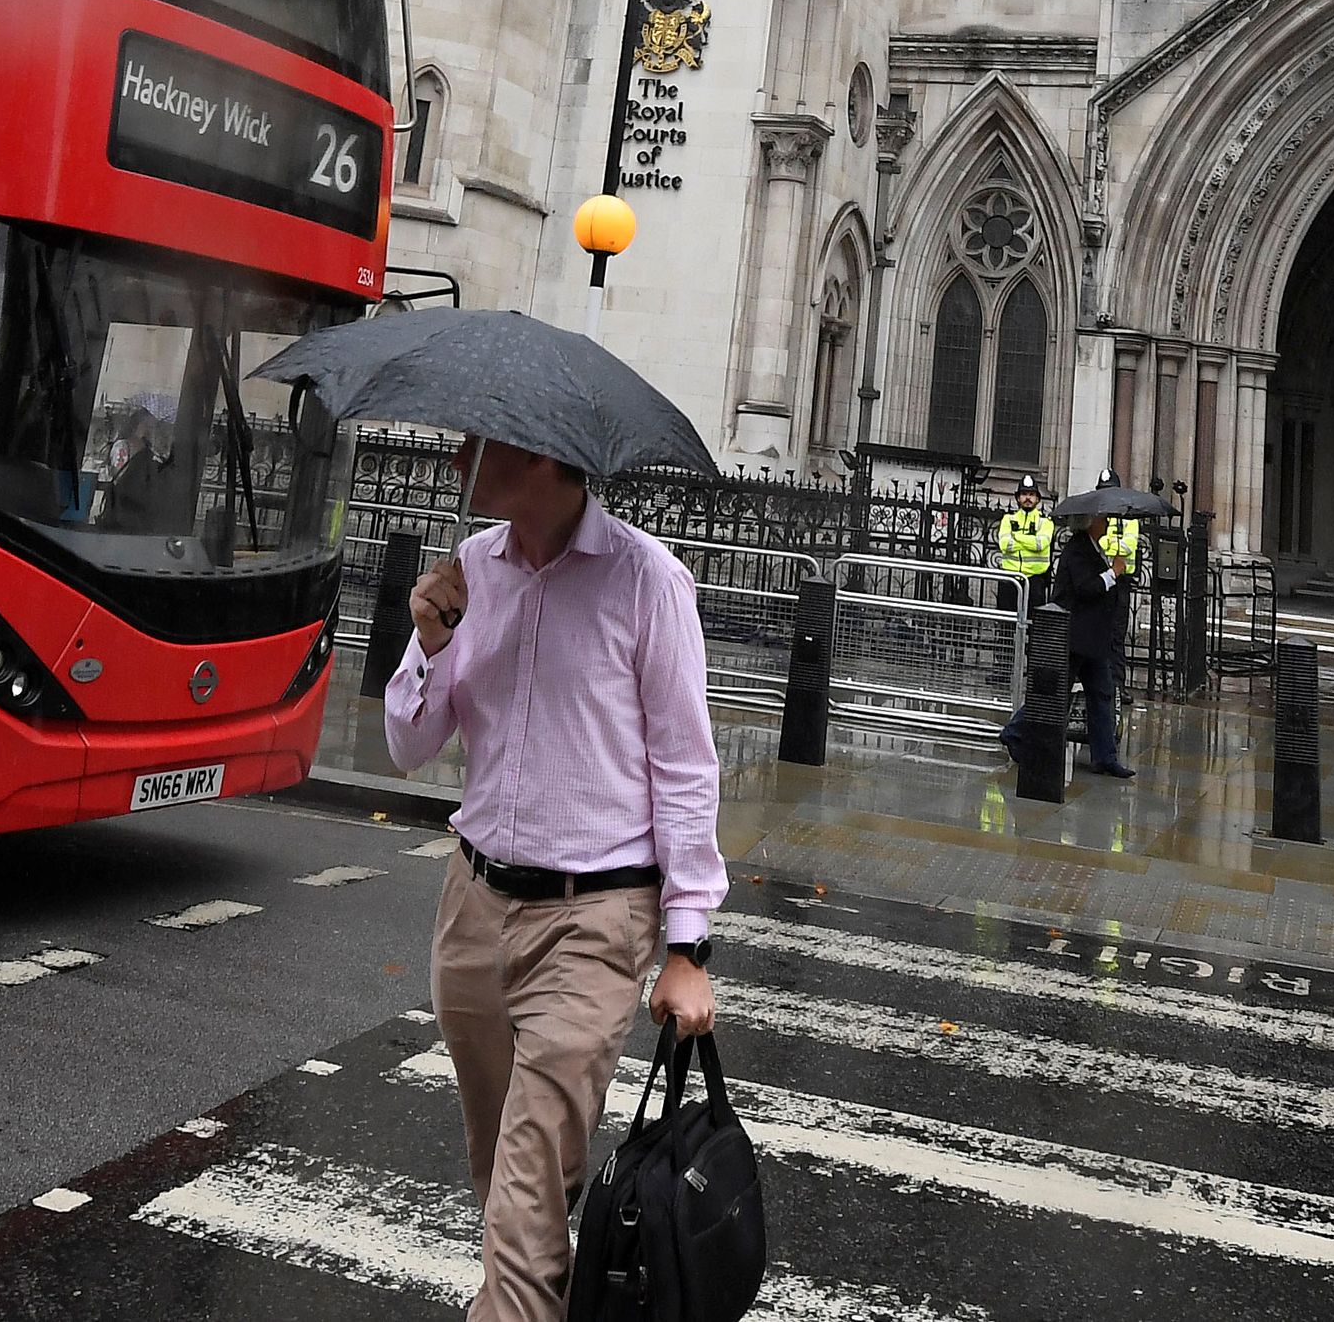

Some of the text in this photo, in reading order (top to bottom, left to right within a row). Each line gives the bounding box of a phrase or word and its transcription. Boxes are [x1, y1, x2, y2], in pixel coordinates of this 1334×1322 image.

[637, 79, 678, 98] The
[122, 60, 272, 147] Hackney Wick
[626, 99, 683, 124] Royal
[623, 123, 687, 145] Courts
[309, 123, 358, 193] 26
[637, 146, 662, 165] of
[357, 266, 374, 287] 2534
[139, 768, 218, 803] SN66 WRX
